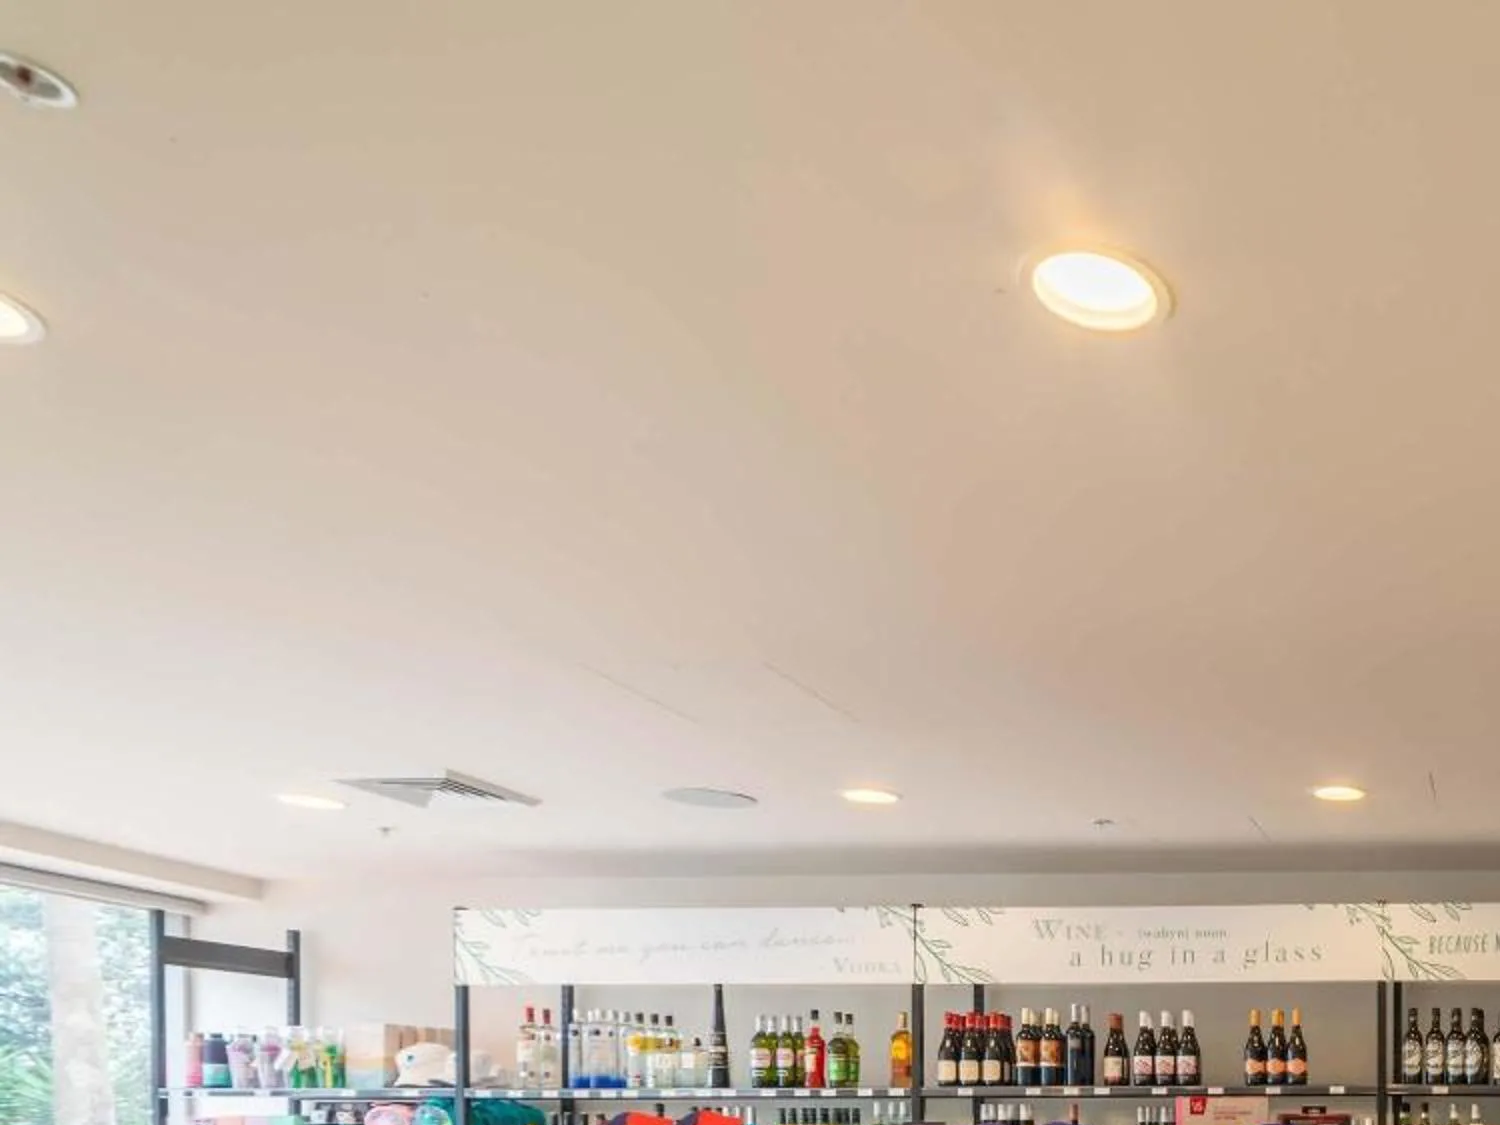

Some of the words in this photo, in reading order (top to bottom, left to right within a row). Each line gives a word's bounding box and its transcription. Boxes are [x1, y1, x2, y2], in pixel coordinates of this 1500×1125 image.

[1069, 951, 1082, 967] a
[1100, 944, 1152, 971] hug
[1171, 943, 1196, 964] in
[1213, 947, 1226, 963] a
[1242, 940, 1323, 970] glass
[1428, 932, 1488, 954] BECAUSE
